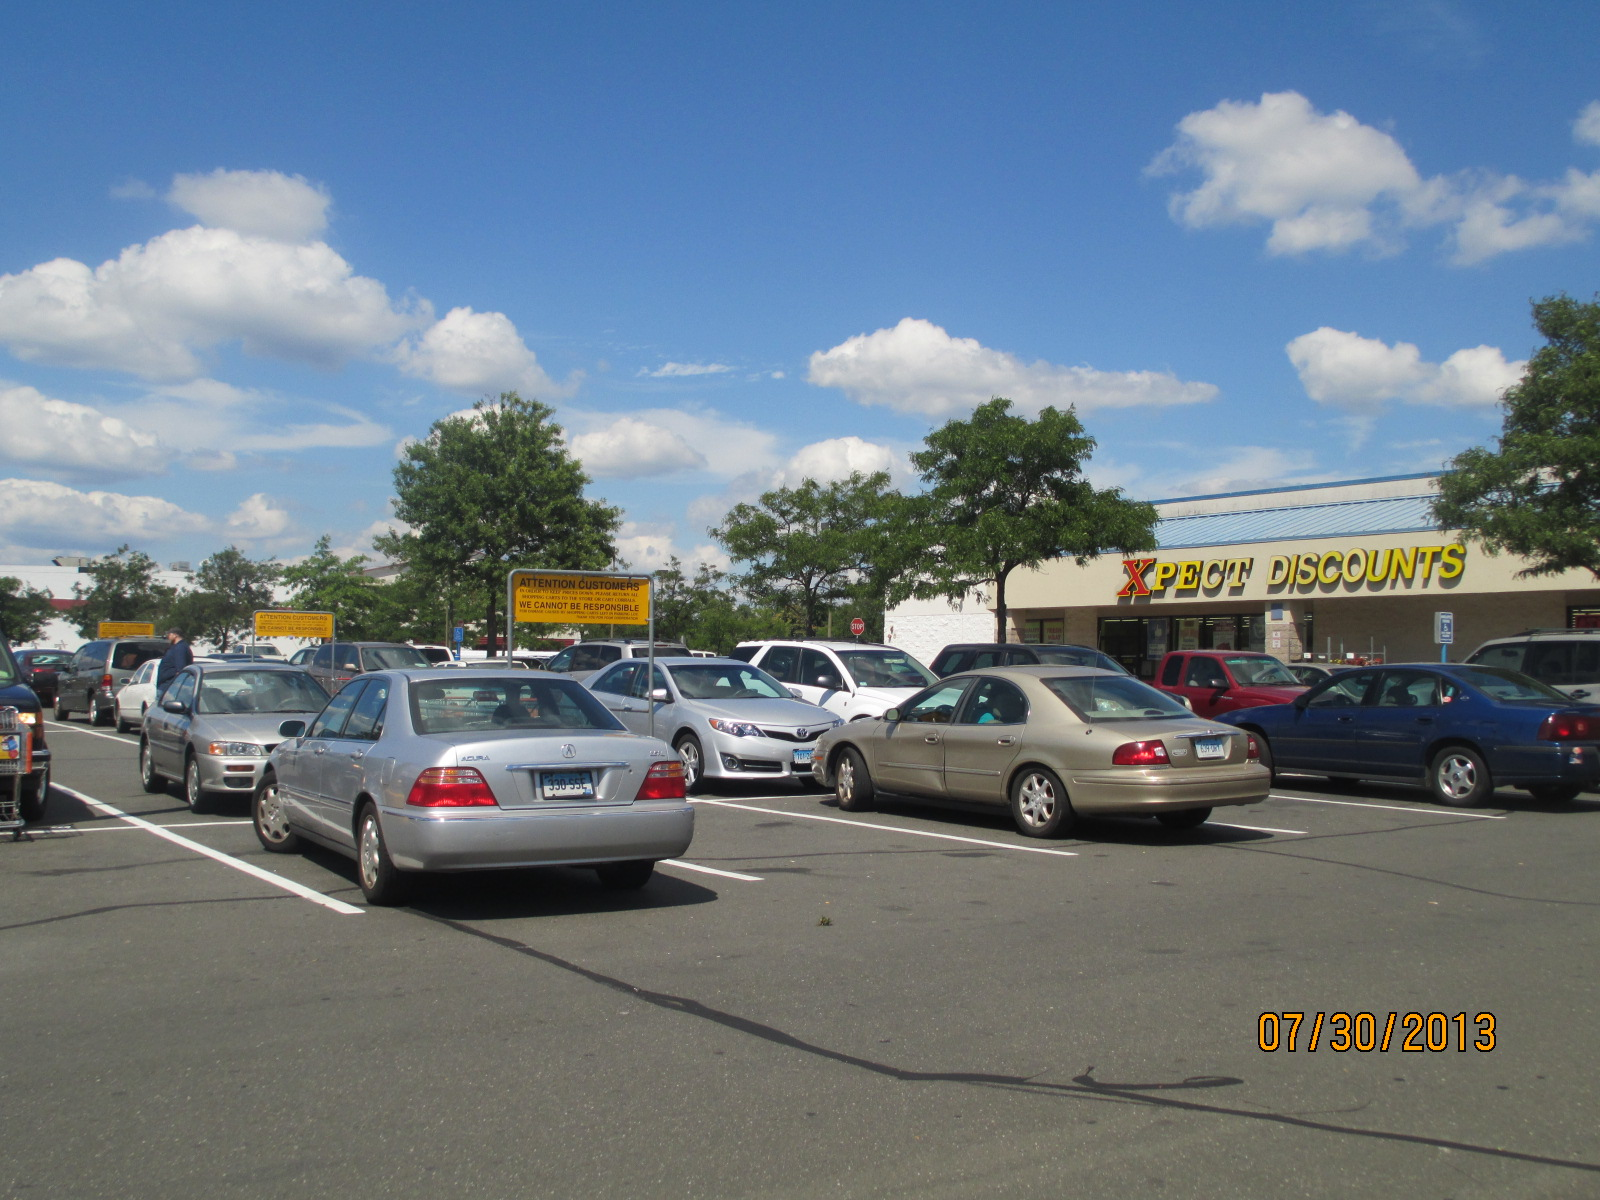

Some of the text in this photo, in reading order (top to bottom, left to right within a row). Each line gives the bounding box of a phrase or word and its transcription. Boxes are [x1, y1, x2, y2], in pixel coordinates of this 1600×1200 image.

[1116, 544, 1466, 597] XPECT DISCOUNTS
[520, 578, 640, 591] ATTENTION CUSTOMERS
[519, 600, 640, 612] WE CANNOT BE RESPONSIBLE
